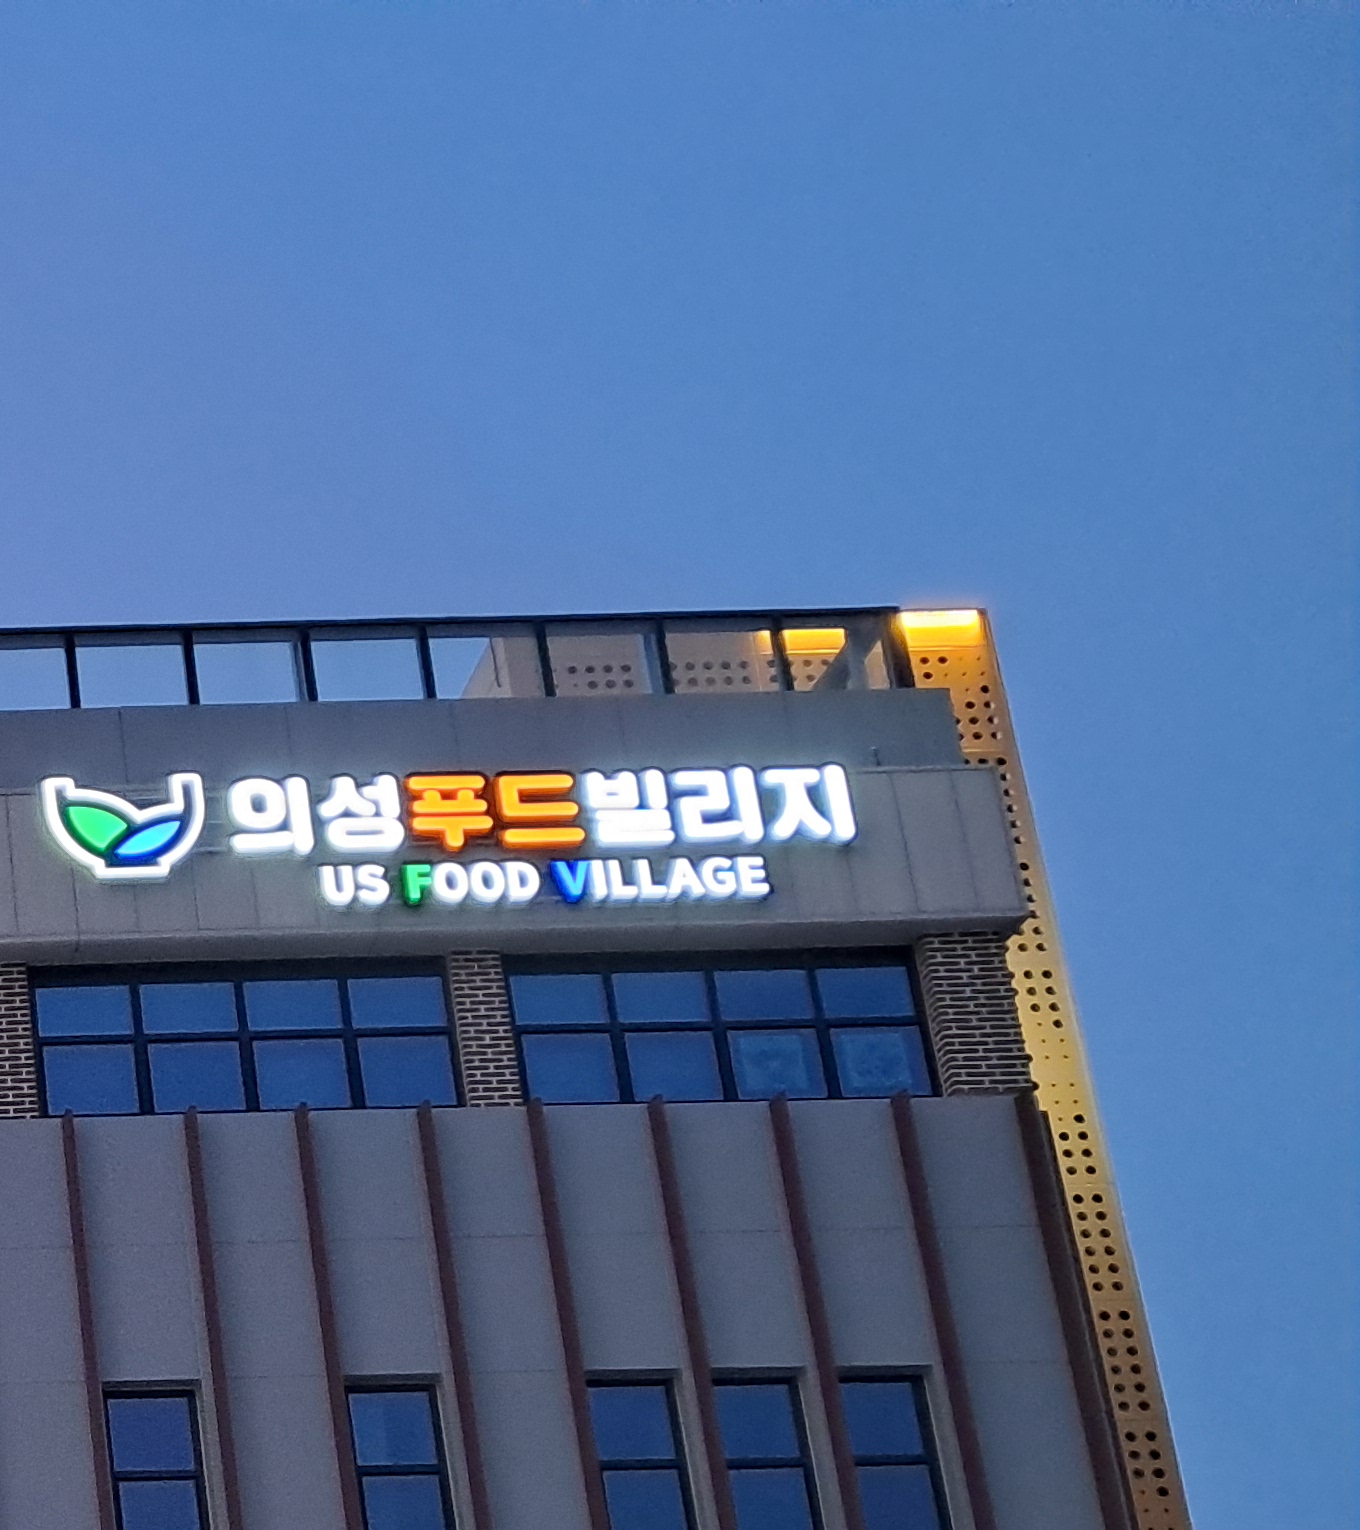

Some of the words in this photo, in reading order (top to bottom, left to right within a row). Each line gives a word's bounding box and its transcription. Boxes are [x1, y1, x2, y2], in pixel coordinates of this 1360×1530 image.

[226, 762, 858, 856] 의성푸드빌리지
[316, 862, 390, 906] US
[402, 858, 542, 904] FOOD
[548, 854, 772, 902] VILLAGE
